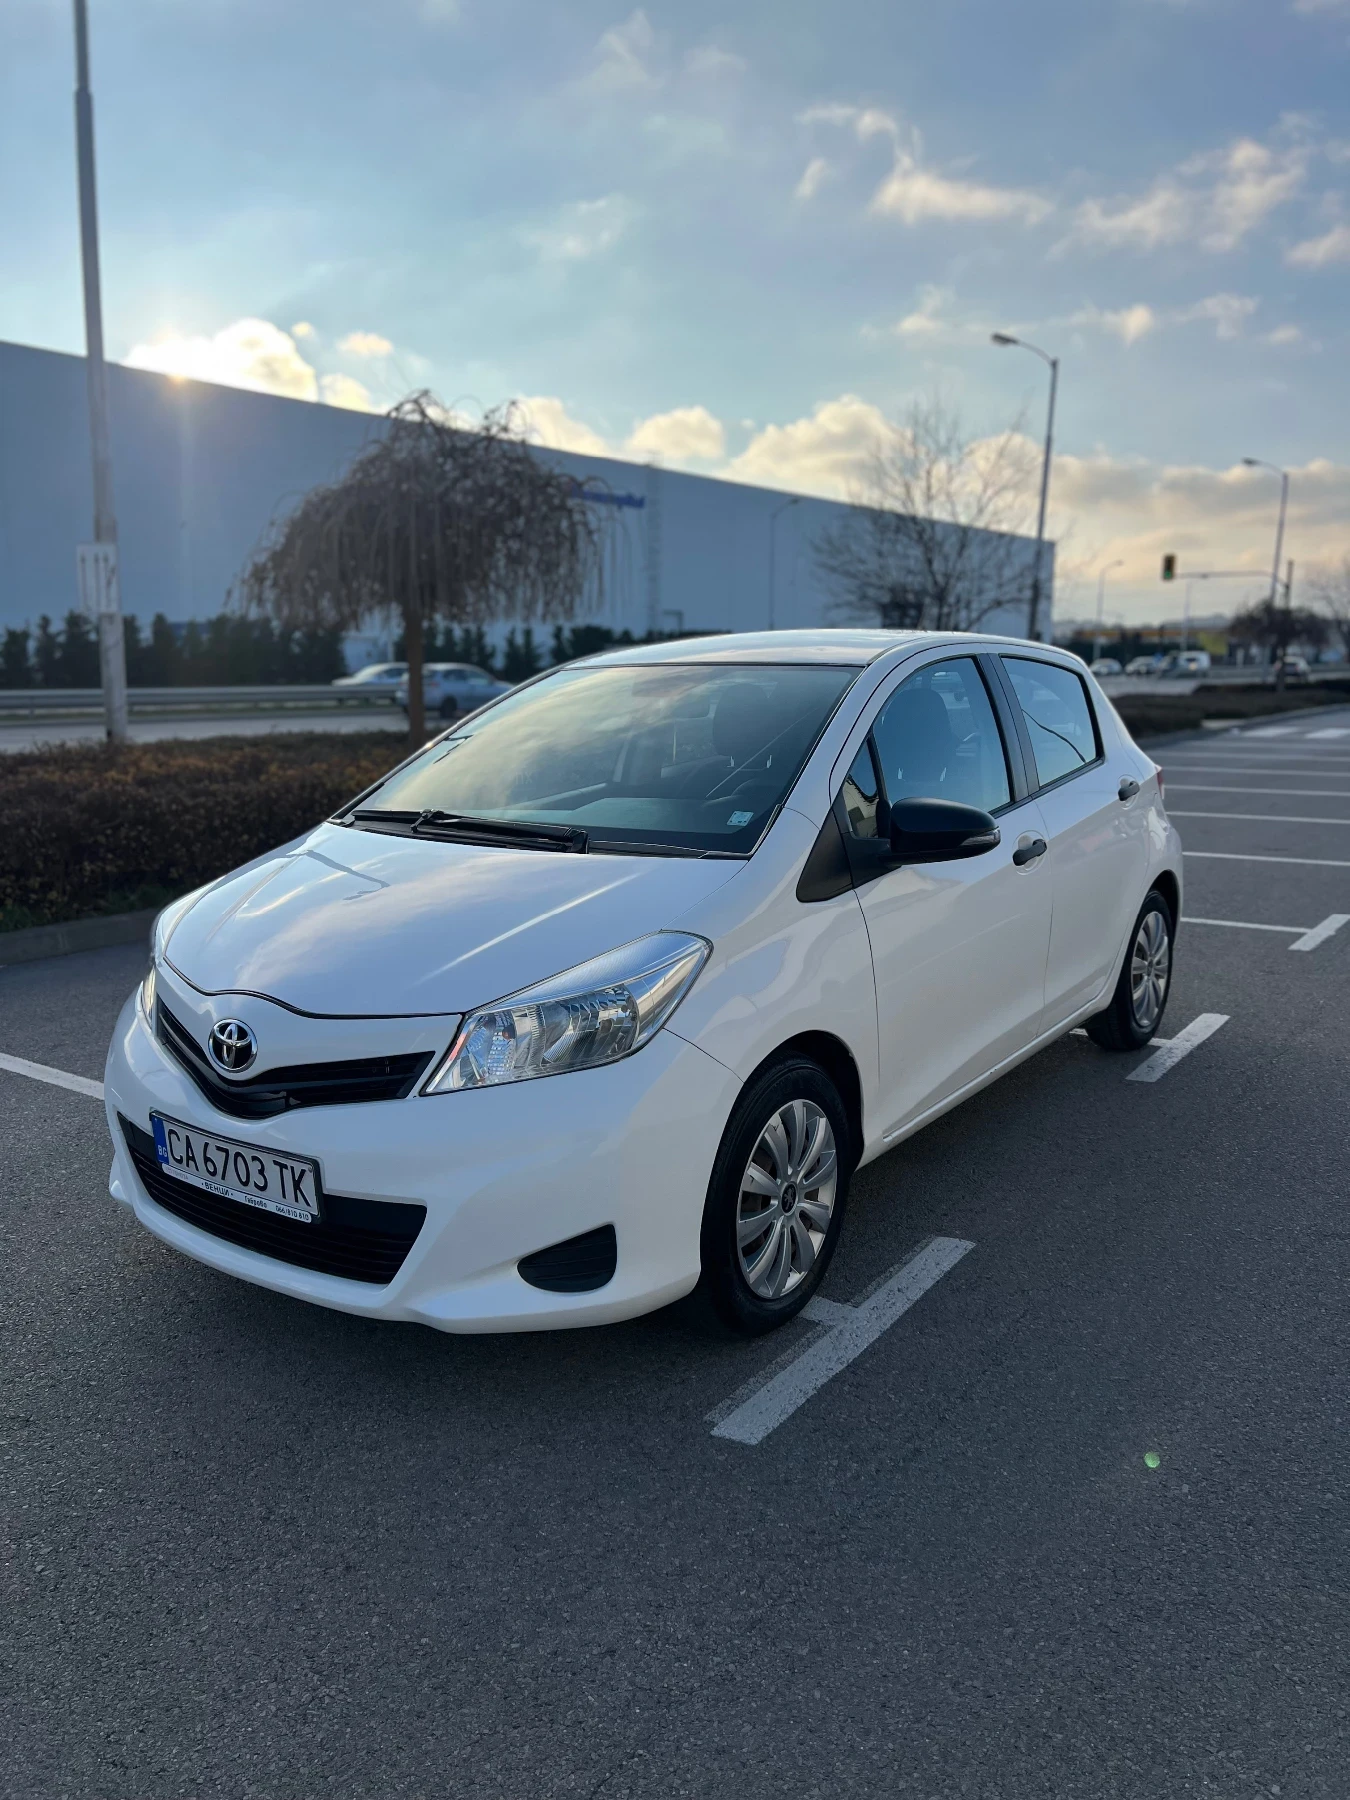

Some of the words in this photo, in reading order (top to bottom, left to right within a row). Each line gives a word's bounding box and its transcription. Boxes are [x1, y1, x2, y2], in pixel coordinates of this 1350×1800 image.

[158, 1145, 168, 1157] BG
[168, 1128, 199, 1172] CA
[203, 1141, 268, 1191] 6703
[272, 1160, 312, 1207] TK
